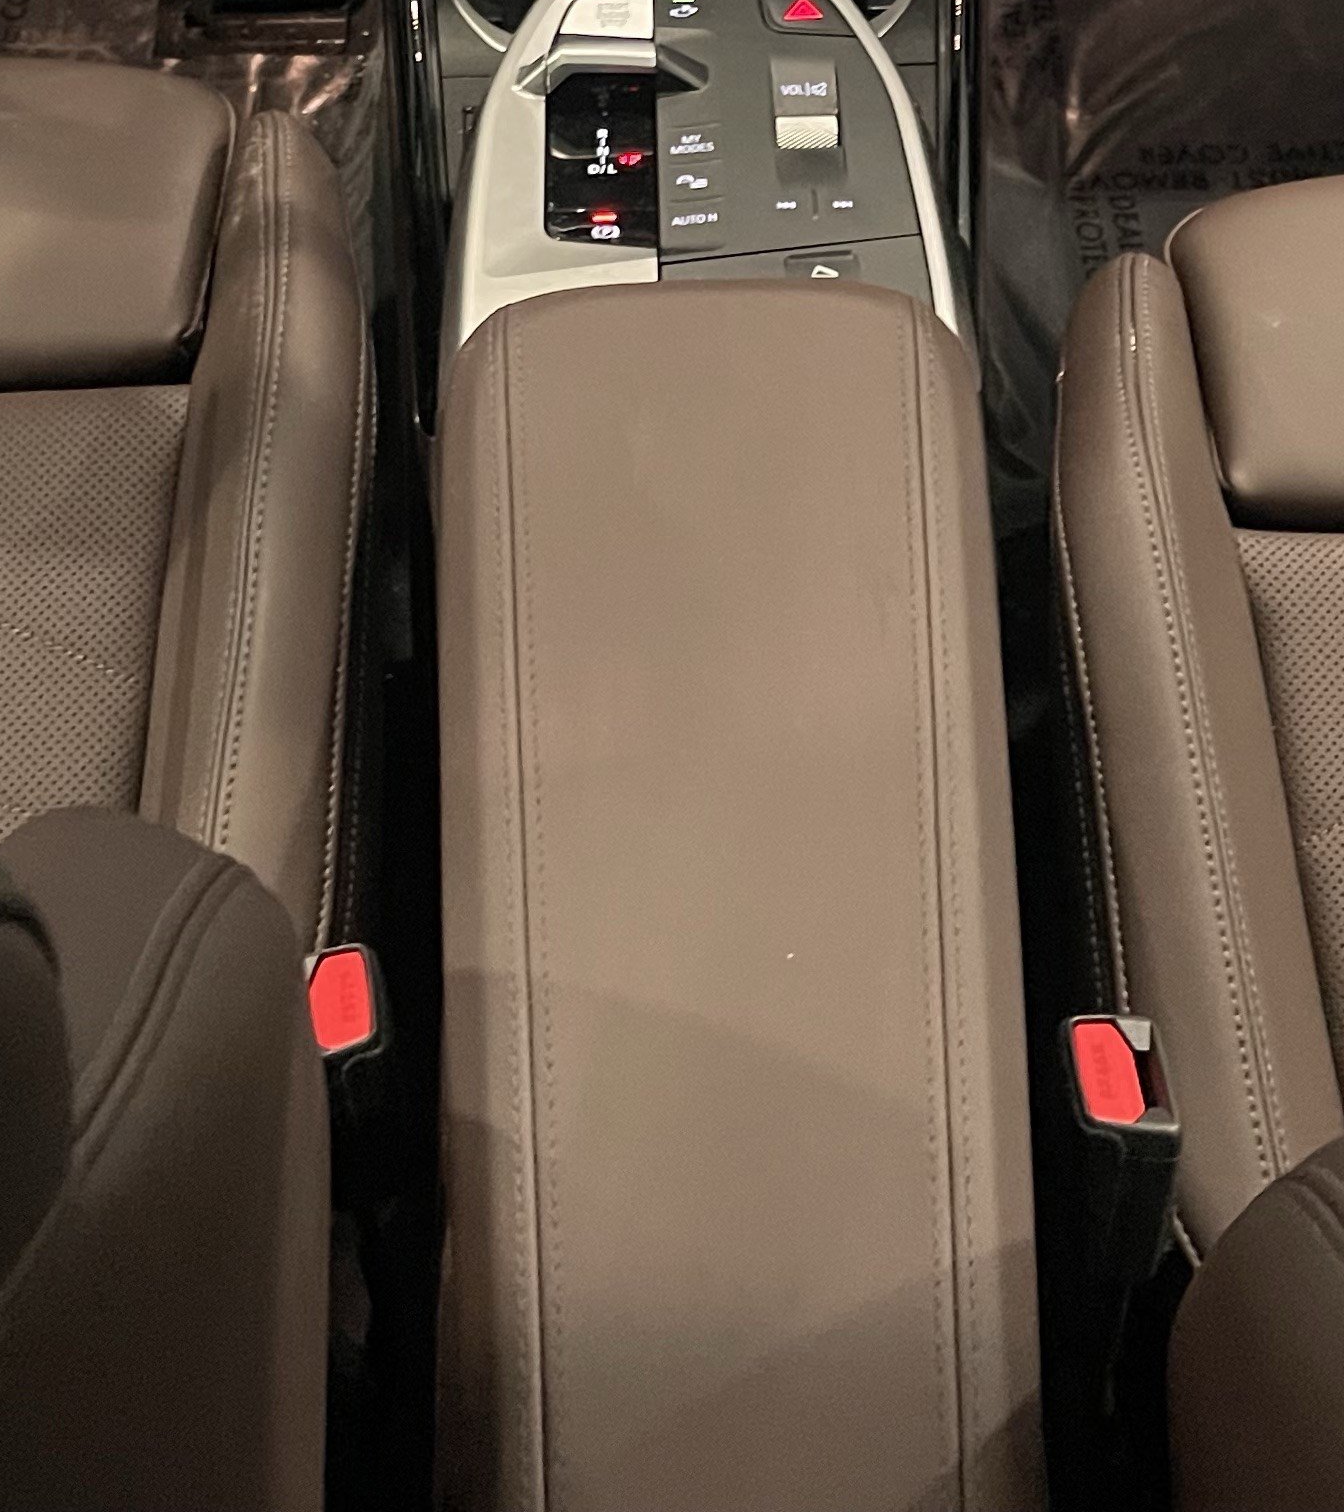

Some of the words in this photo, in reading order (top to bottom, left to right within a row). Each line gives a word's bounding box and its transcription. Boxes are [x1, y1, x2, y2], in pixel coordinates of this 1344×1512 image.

[669, 141, 716, 155] MODES
[671, 213, 706, 227] AUTO
[707, 212, 718, 223] H
